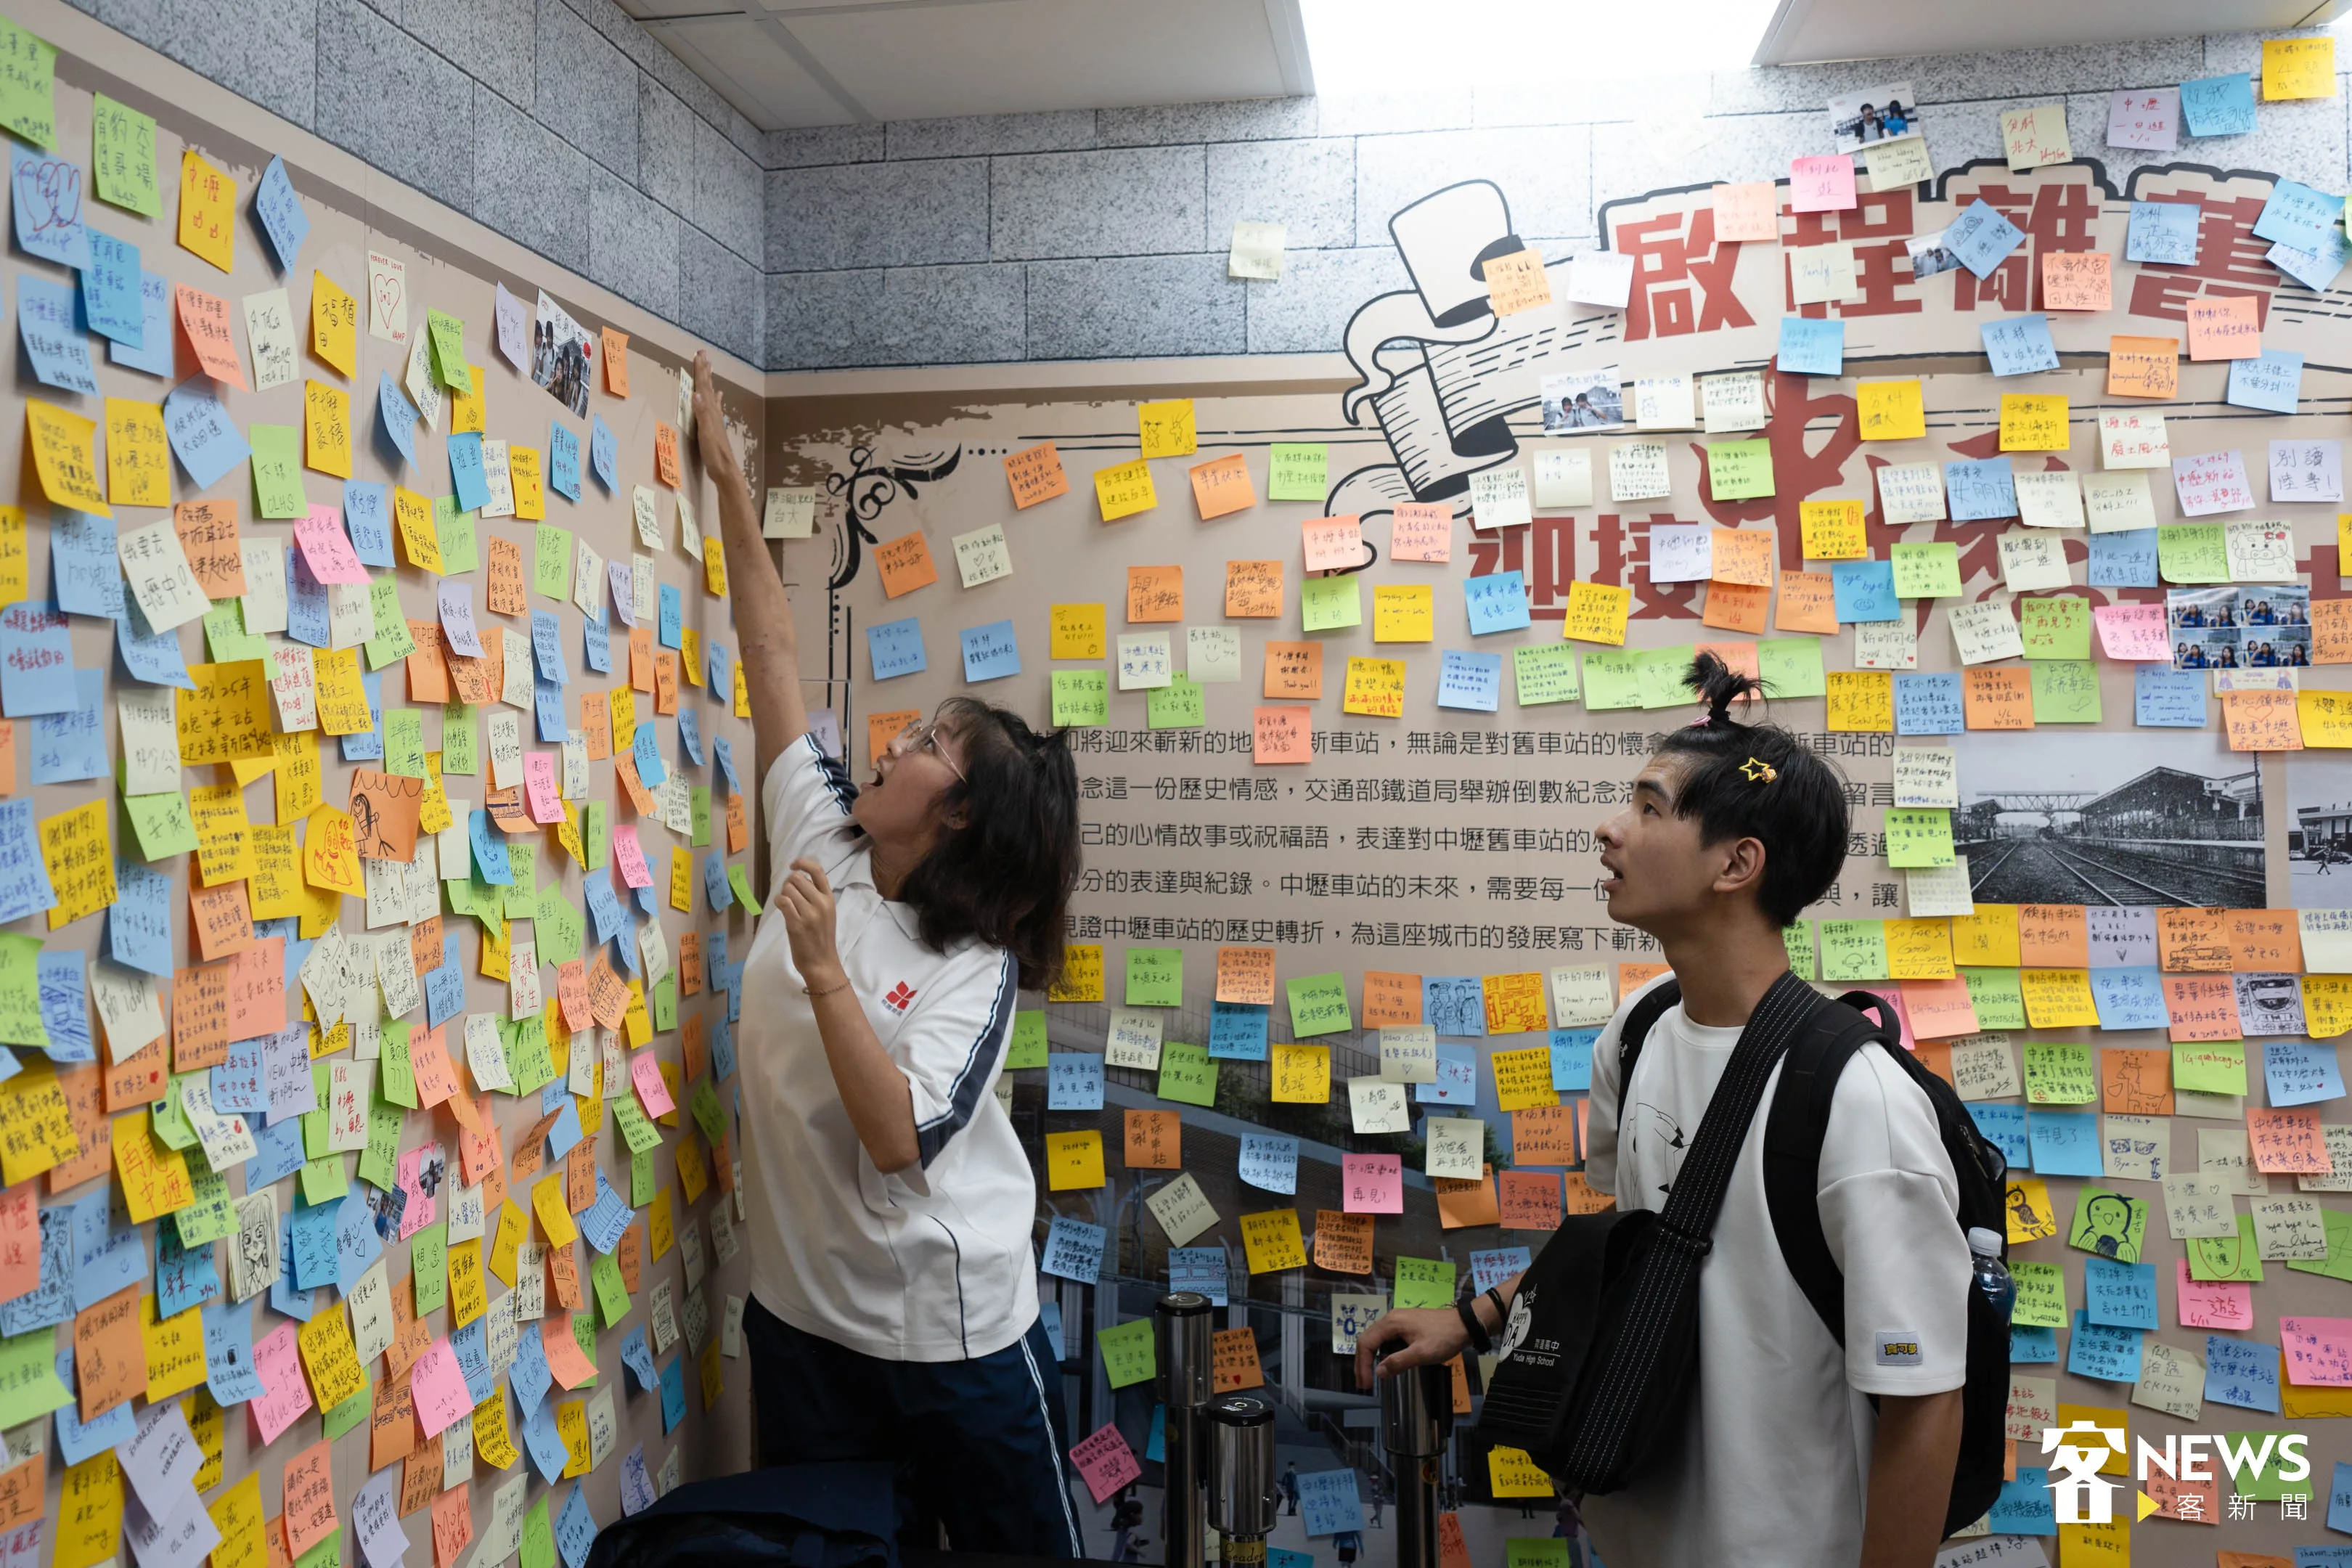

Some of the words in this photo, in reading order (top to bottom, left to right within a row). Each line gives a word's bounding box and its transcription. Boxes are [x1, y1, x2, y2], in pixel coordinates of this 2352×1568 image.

[1082, 822, 1604, 854] 己的心情故事或祝福語，表達對中壢舊車站的
[1513, 1352, 1524, 1363] Yuda
[1525, 1355, 1536, 1365] High
[1537, 1355, 1555, 1367] School
